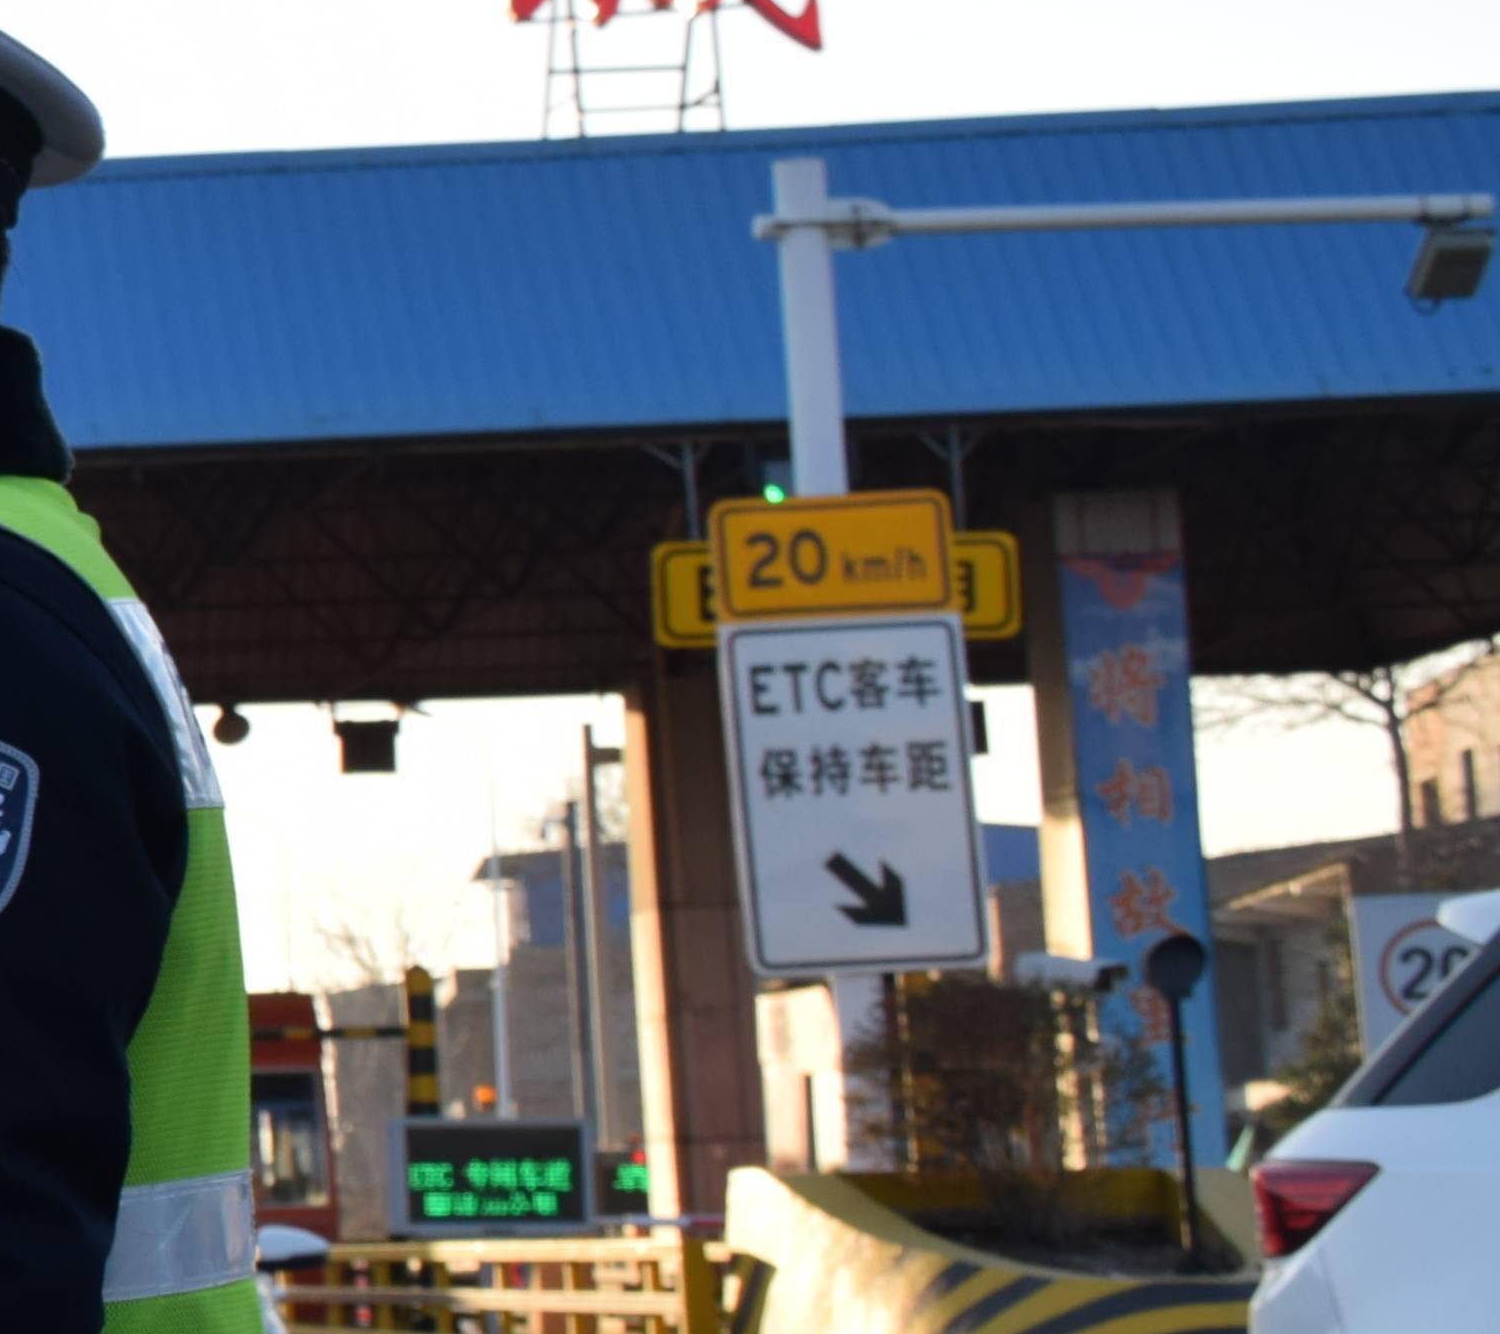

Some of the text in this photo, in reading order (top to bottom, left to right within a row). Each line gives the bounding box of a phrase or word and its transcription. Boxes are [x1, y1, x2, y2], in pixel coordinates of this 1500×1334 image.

[746, 529, 928, 590] 20 km/h
[749, 656, 940, 716] ETC客车
[761, 740, 952, 798] 保持车距
